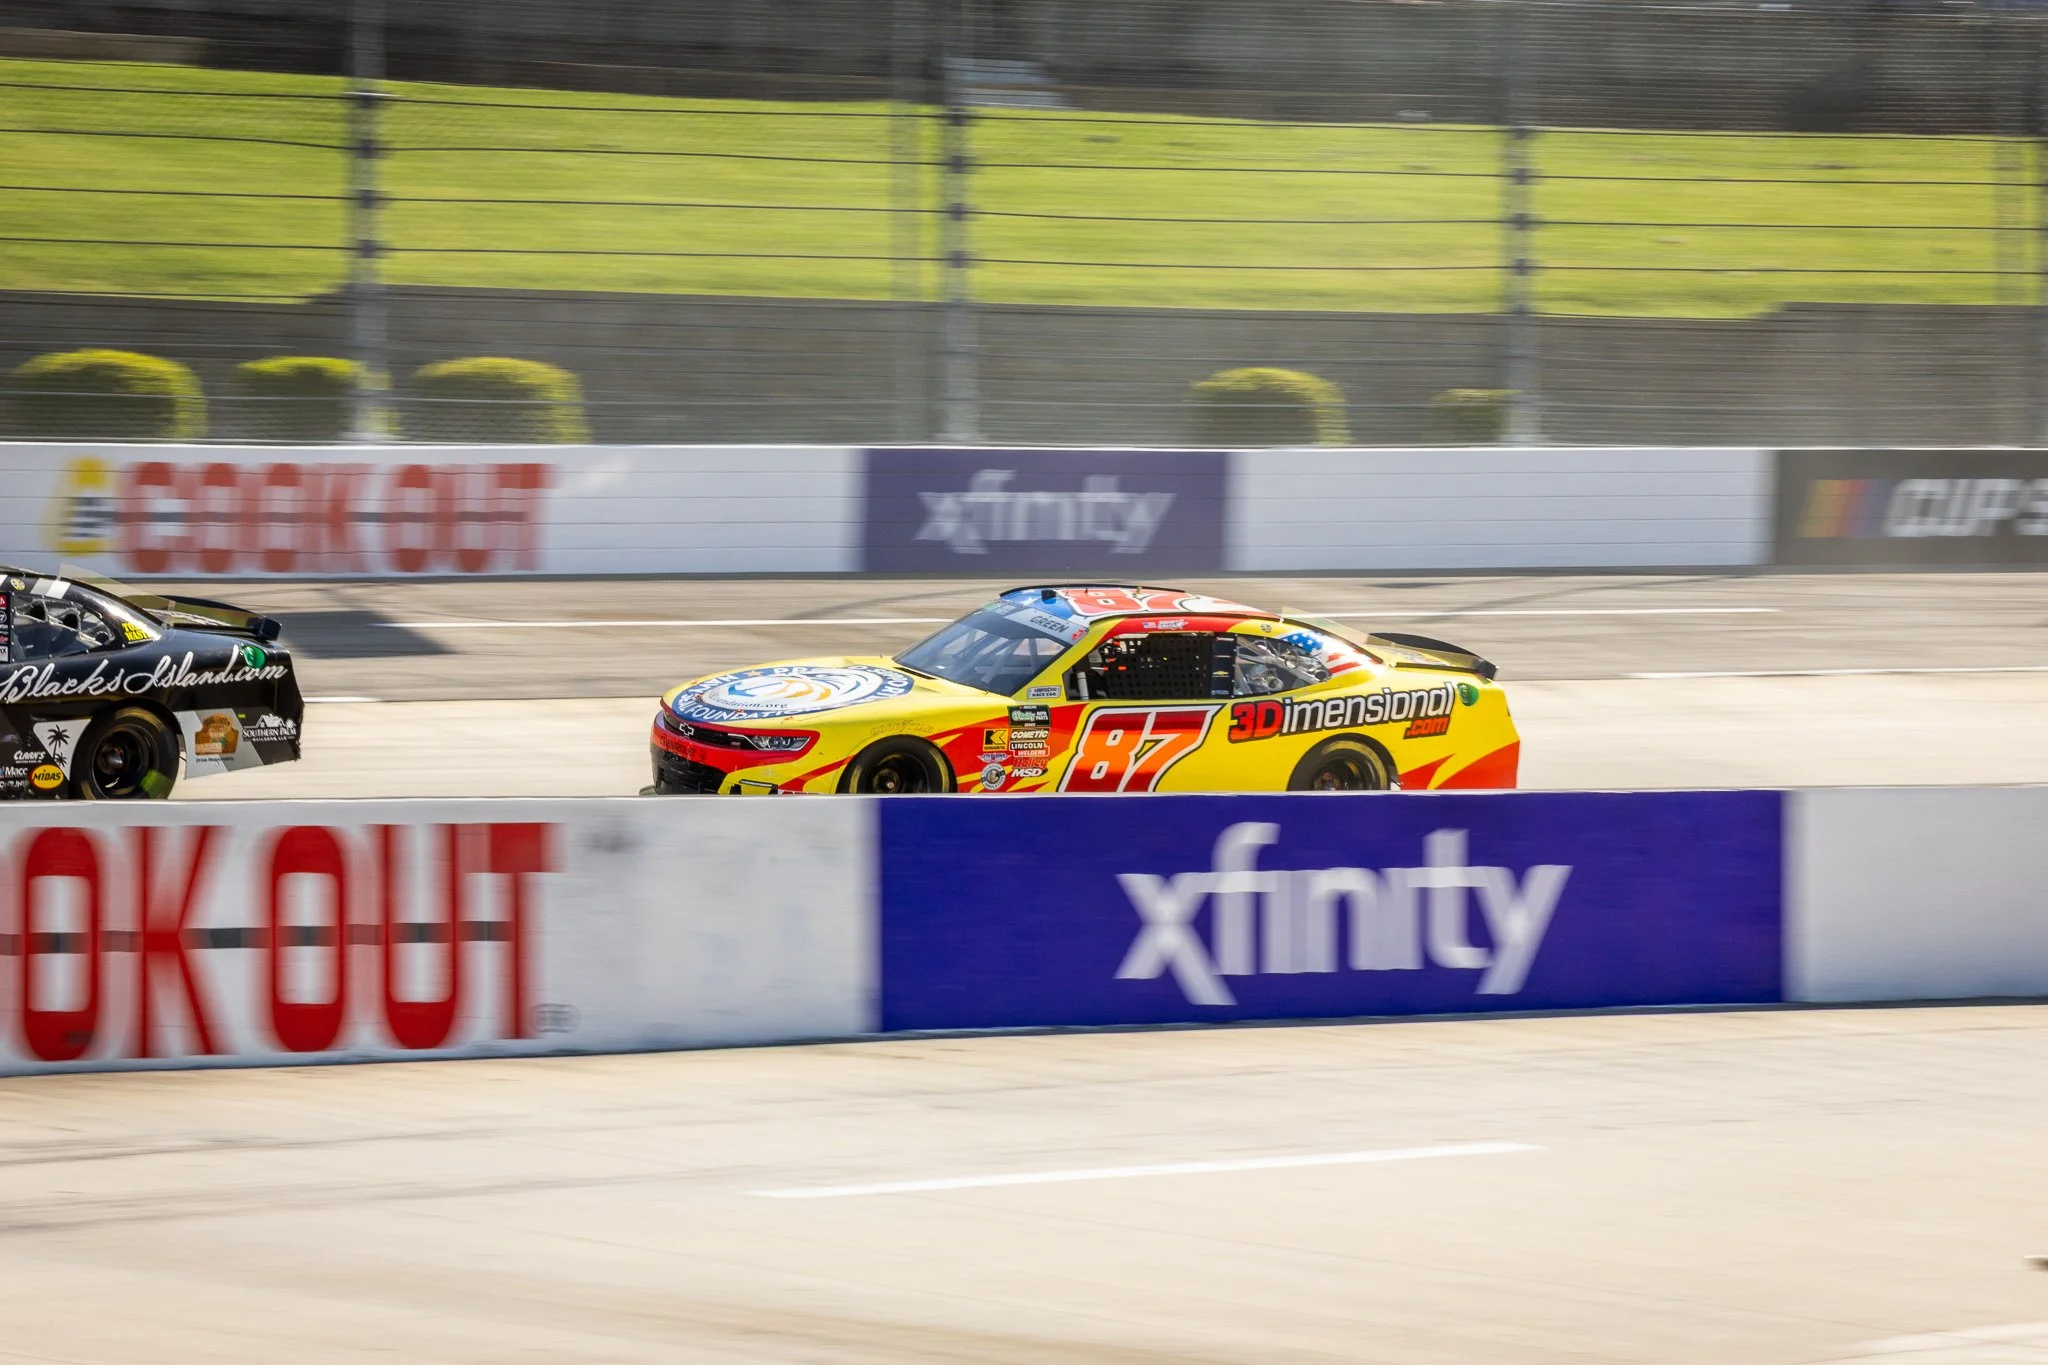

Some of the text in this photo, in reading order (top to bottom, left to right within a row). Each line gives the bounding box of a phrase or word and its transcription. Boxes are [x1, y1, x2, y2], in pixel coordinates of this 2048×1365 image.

[912, 469, 1177, 554] xfinity
[1030, 616, 1069, 633] GREEN
[1011, 742, 1043, 750] LINCOLN
[1058, 704, 1226, 792] 87
[1228, 683, 1455, 743] 3Dimensional
[1011, 768, 1043, 777] MSD
[0, 822, 567, 1062] OK OUT
[1113, 821, 1574, 1006] xfinity
